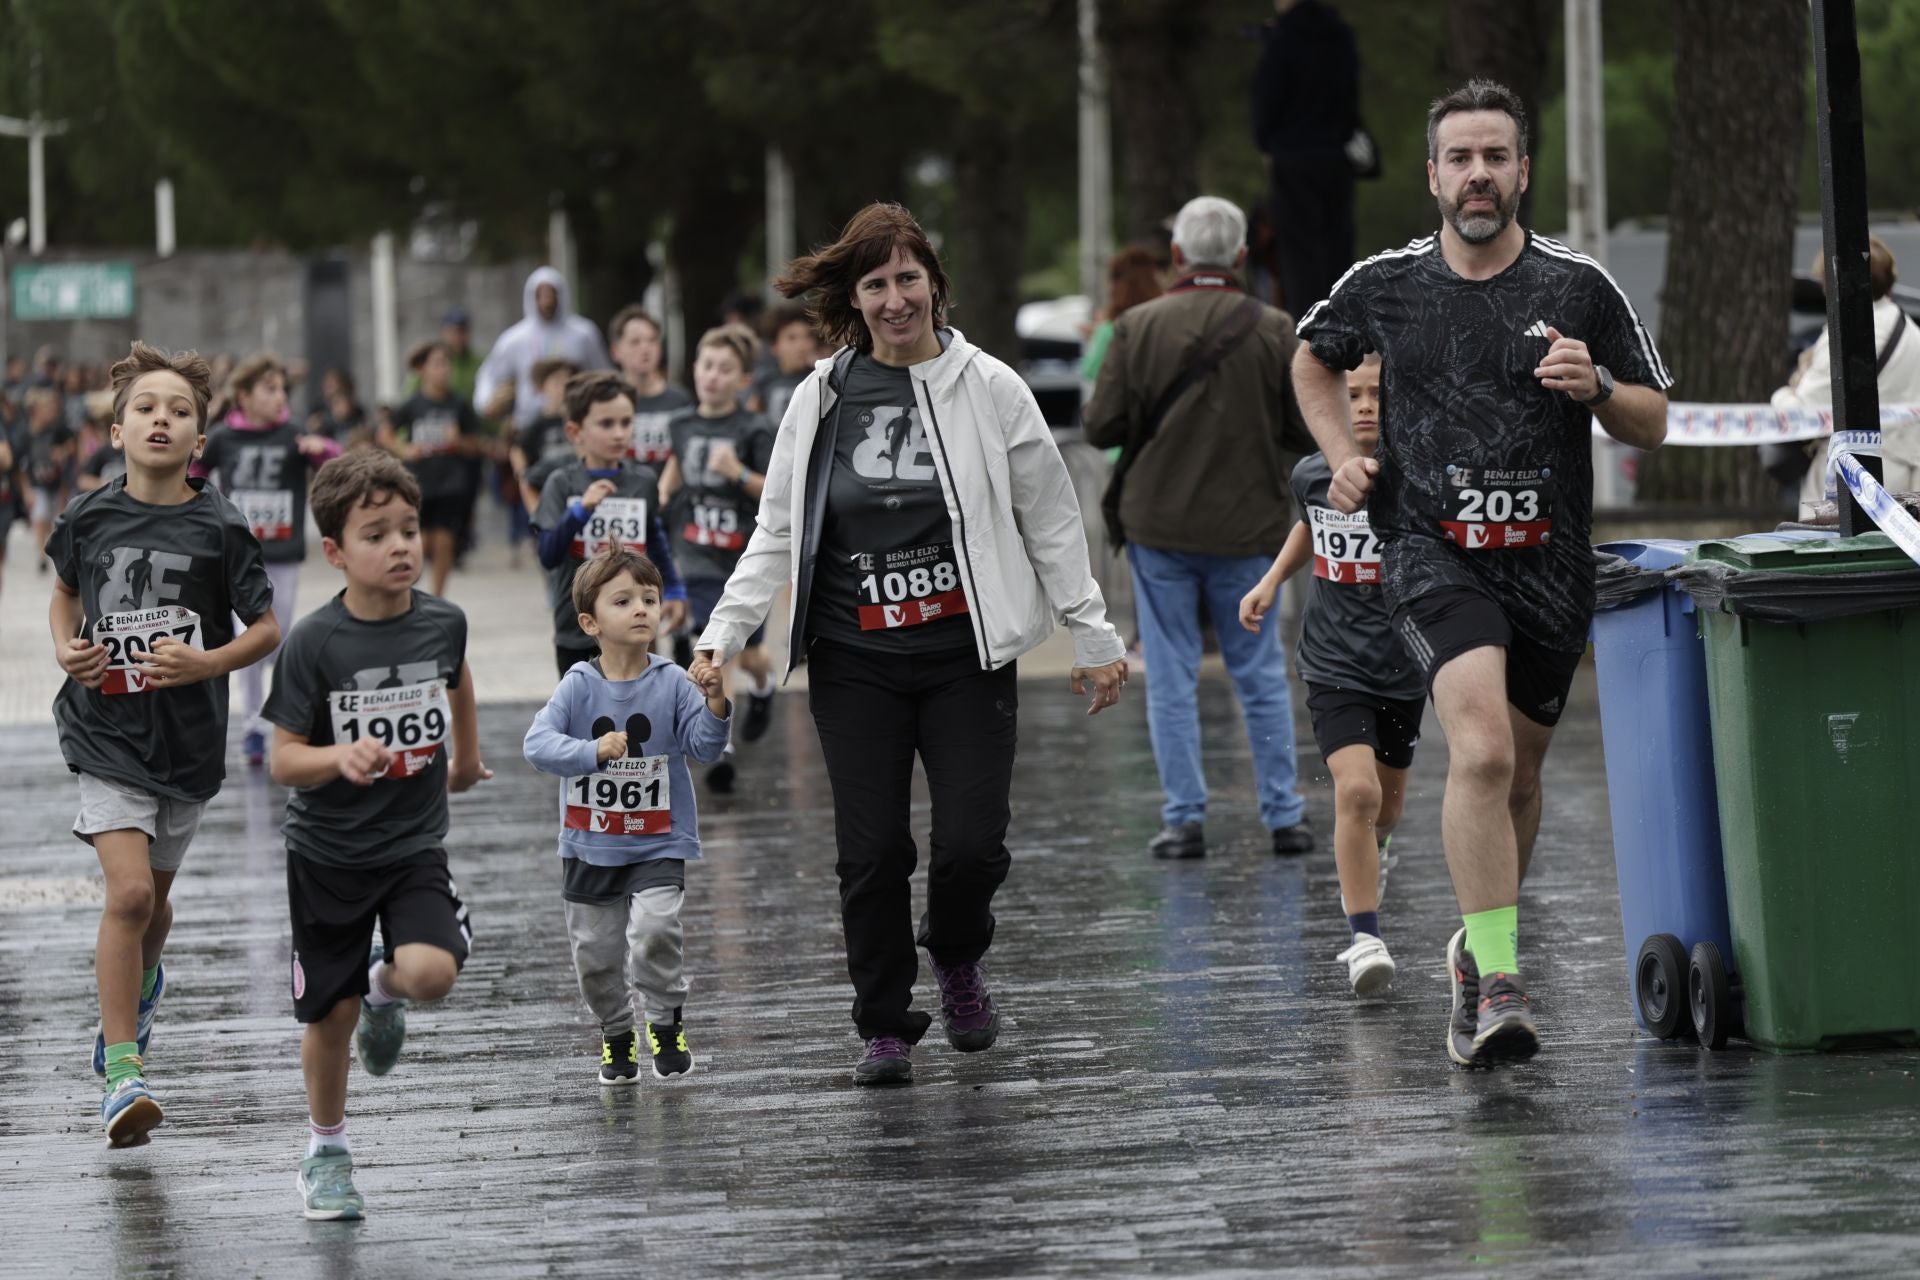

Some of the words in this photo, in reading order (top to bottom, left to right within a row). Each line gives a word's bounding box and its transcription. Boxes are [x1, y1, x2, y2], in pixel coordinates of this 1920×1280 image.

[1483, 469, 1515, 479] BEÑAT
[1516, 470, 1538, 479] ELZO
[1456, 489, 1539, 522] 203
[577, 517, 640, 539] 863
[102, 555, 110, 563] 10
[886, 551, 916, 562] BEÑAT
[917, 546, 940, 556] ELZO
[886, 560, 909, 569] MENDI
[911, 554, 940, 565] MARTXA
[861, 562, 957, 604] 1088
[920, 603, 941, 612] DIARIO
[921, 609, 942, 618] VASCO
[116, 613, 143, 625] BEÑAT
[145, 610, 169, 621] ELZO
[134, 620, 170, 630] LASTERKETA
[399, 689, 422, 701] ELZO
[342, 707, 445, 748] 1969
[625, 761, 647, 769] ELZO
[575, 776, 660, 809] 1961
